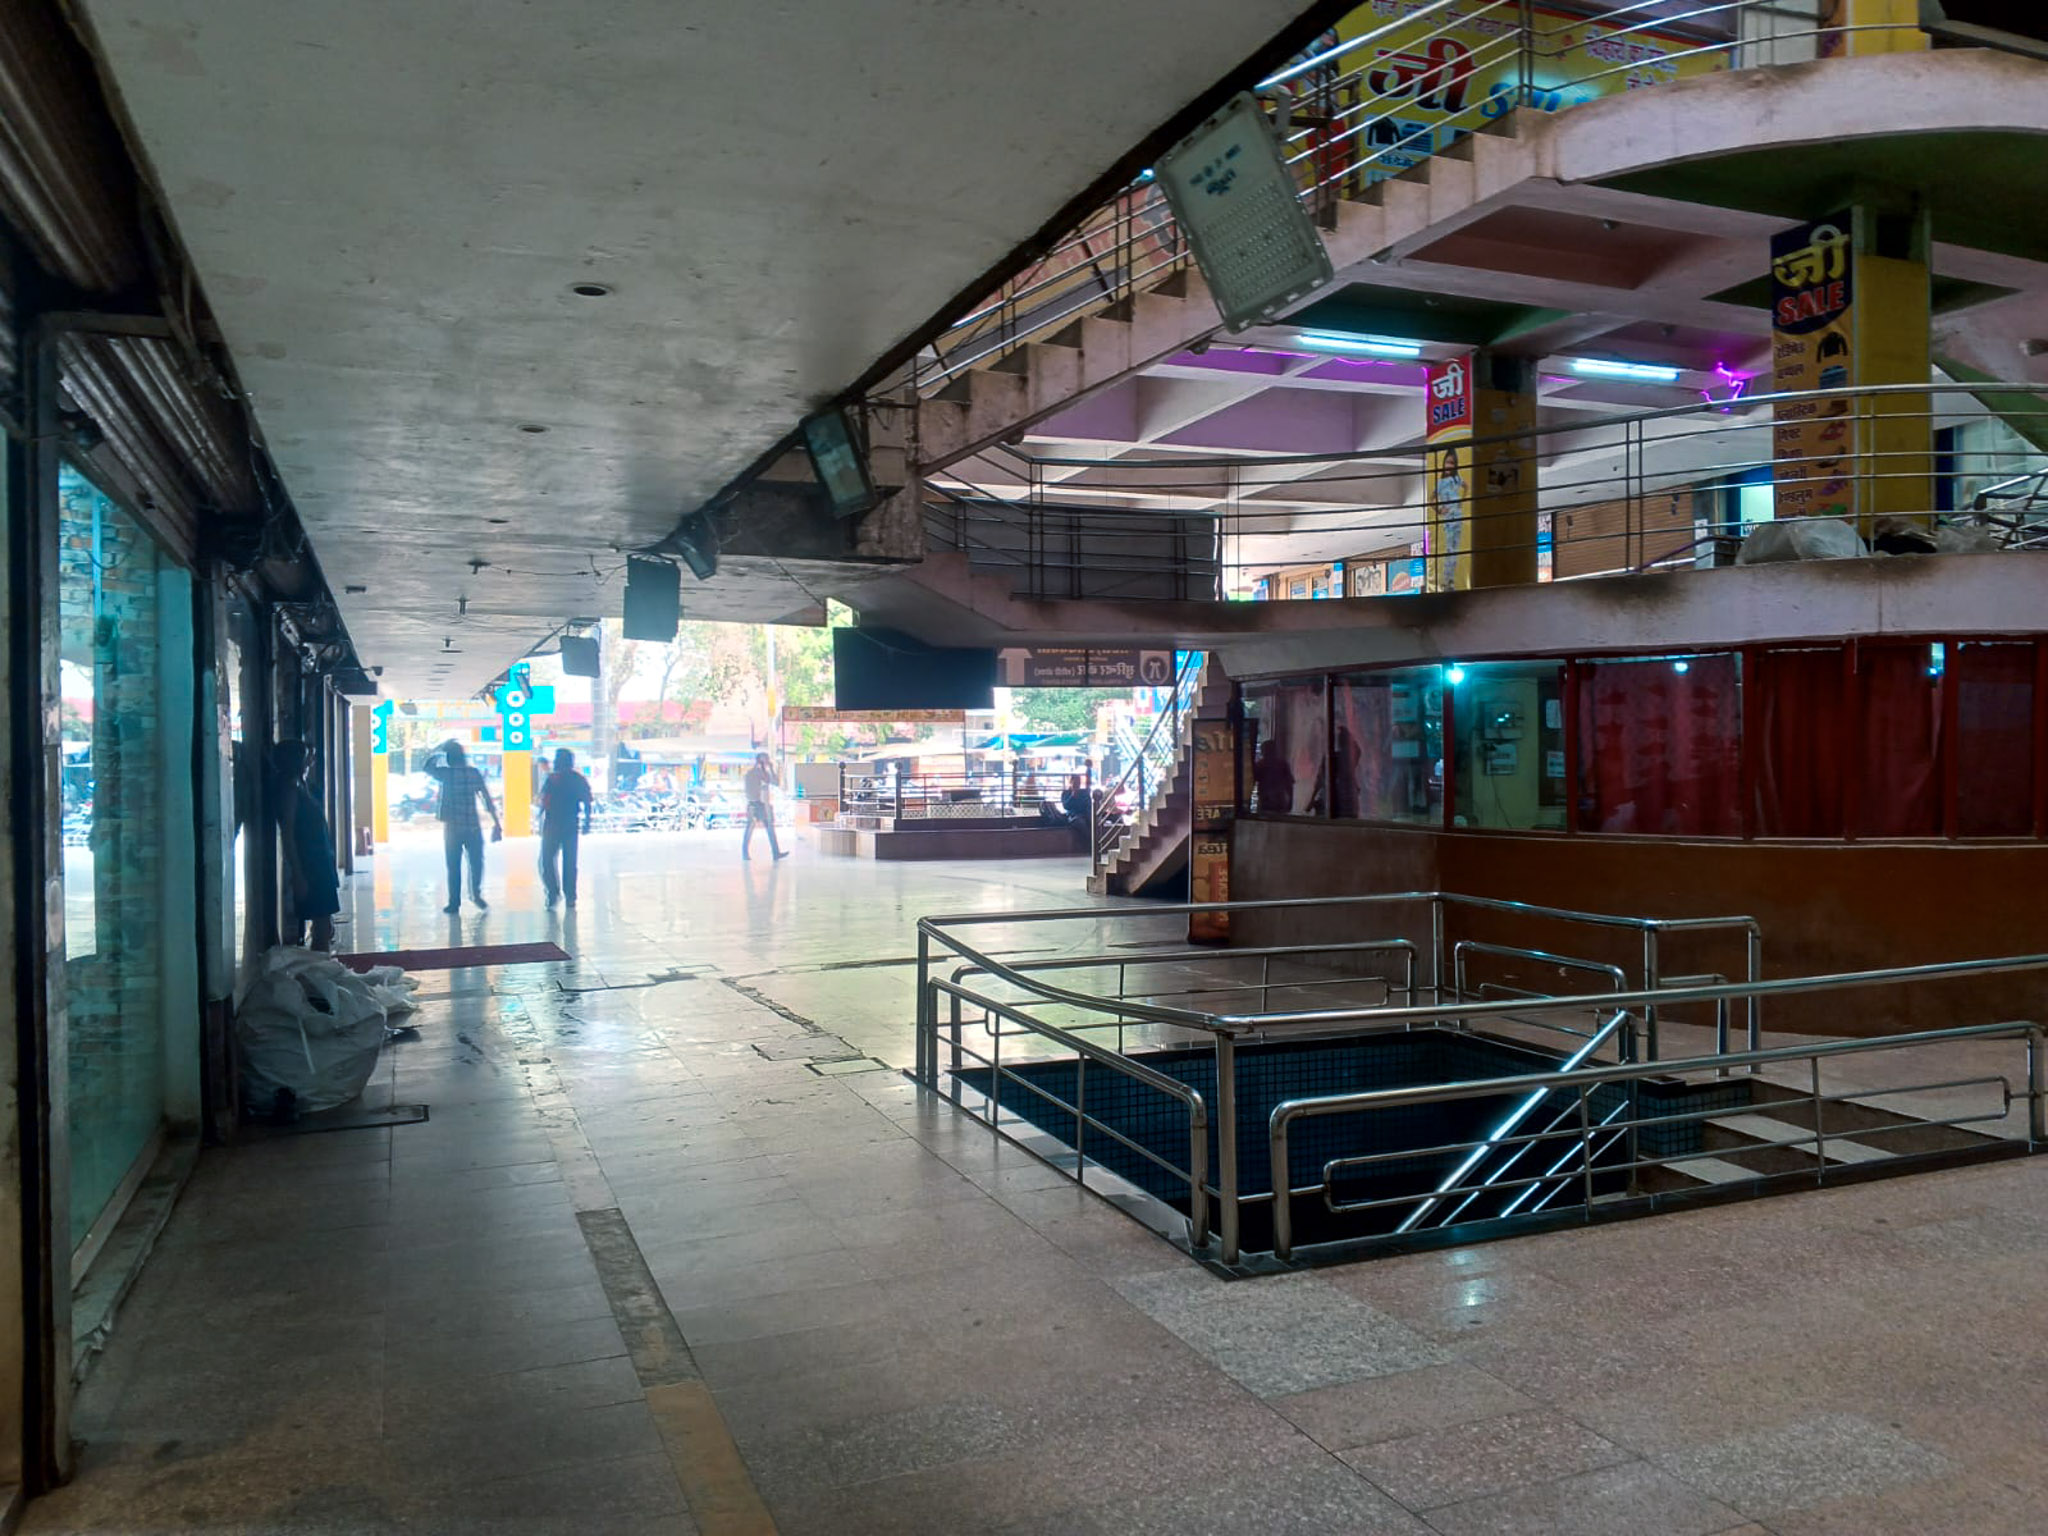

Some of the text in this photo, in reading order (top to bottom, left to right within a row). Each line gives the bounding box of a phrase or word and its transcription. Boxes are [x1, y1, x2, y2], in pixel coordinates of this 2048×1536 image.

[1772, 224, 1850, 287] जी
[1777, 281, 1845, 325] SALE
[1431, 362, 1465, 399] जी
[1432, 397, 1466, 426] SALE
